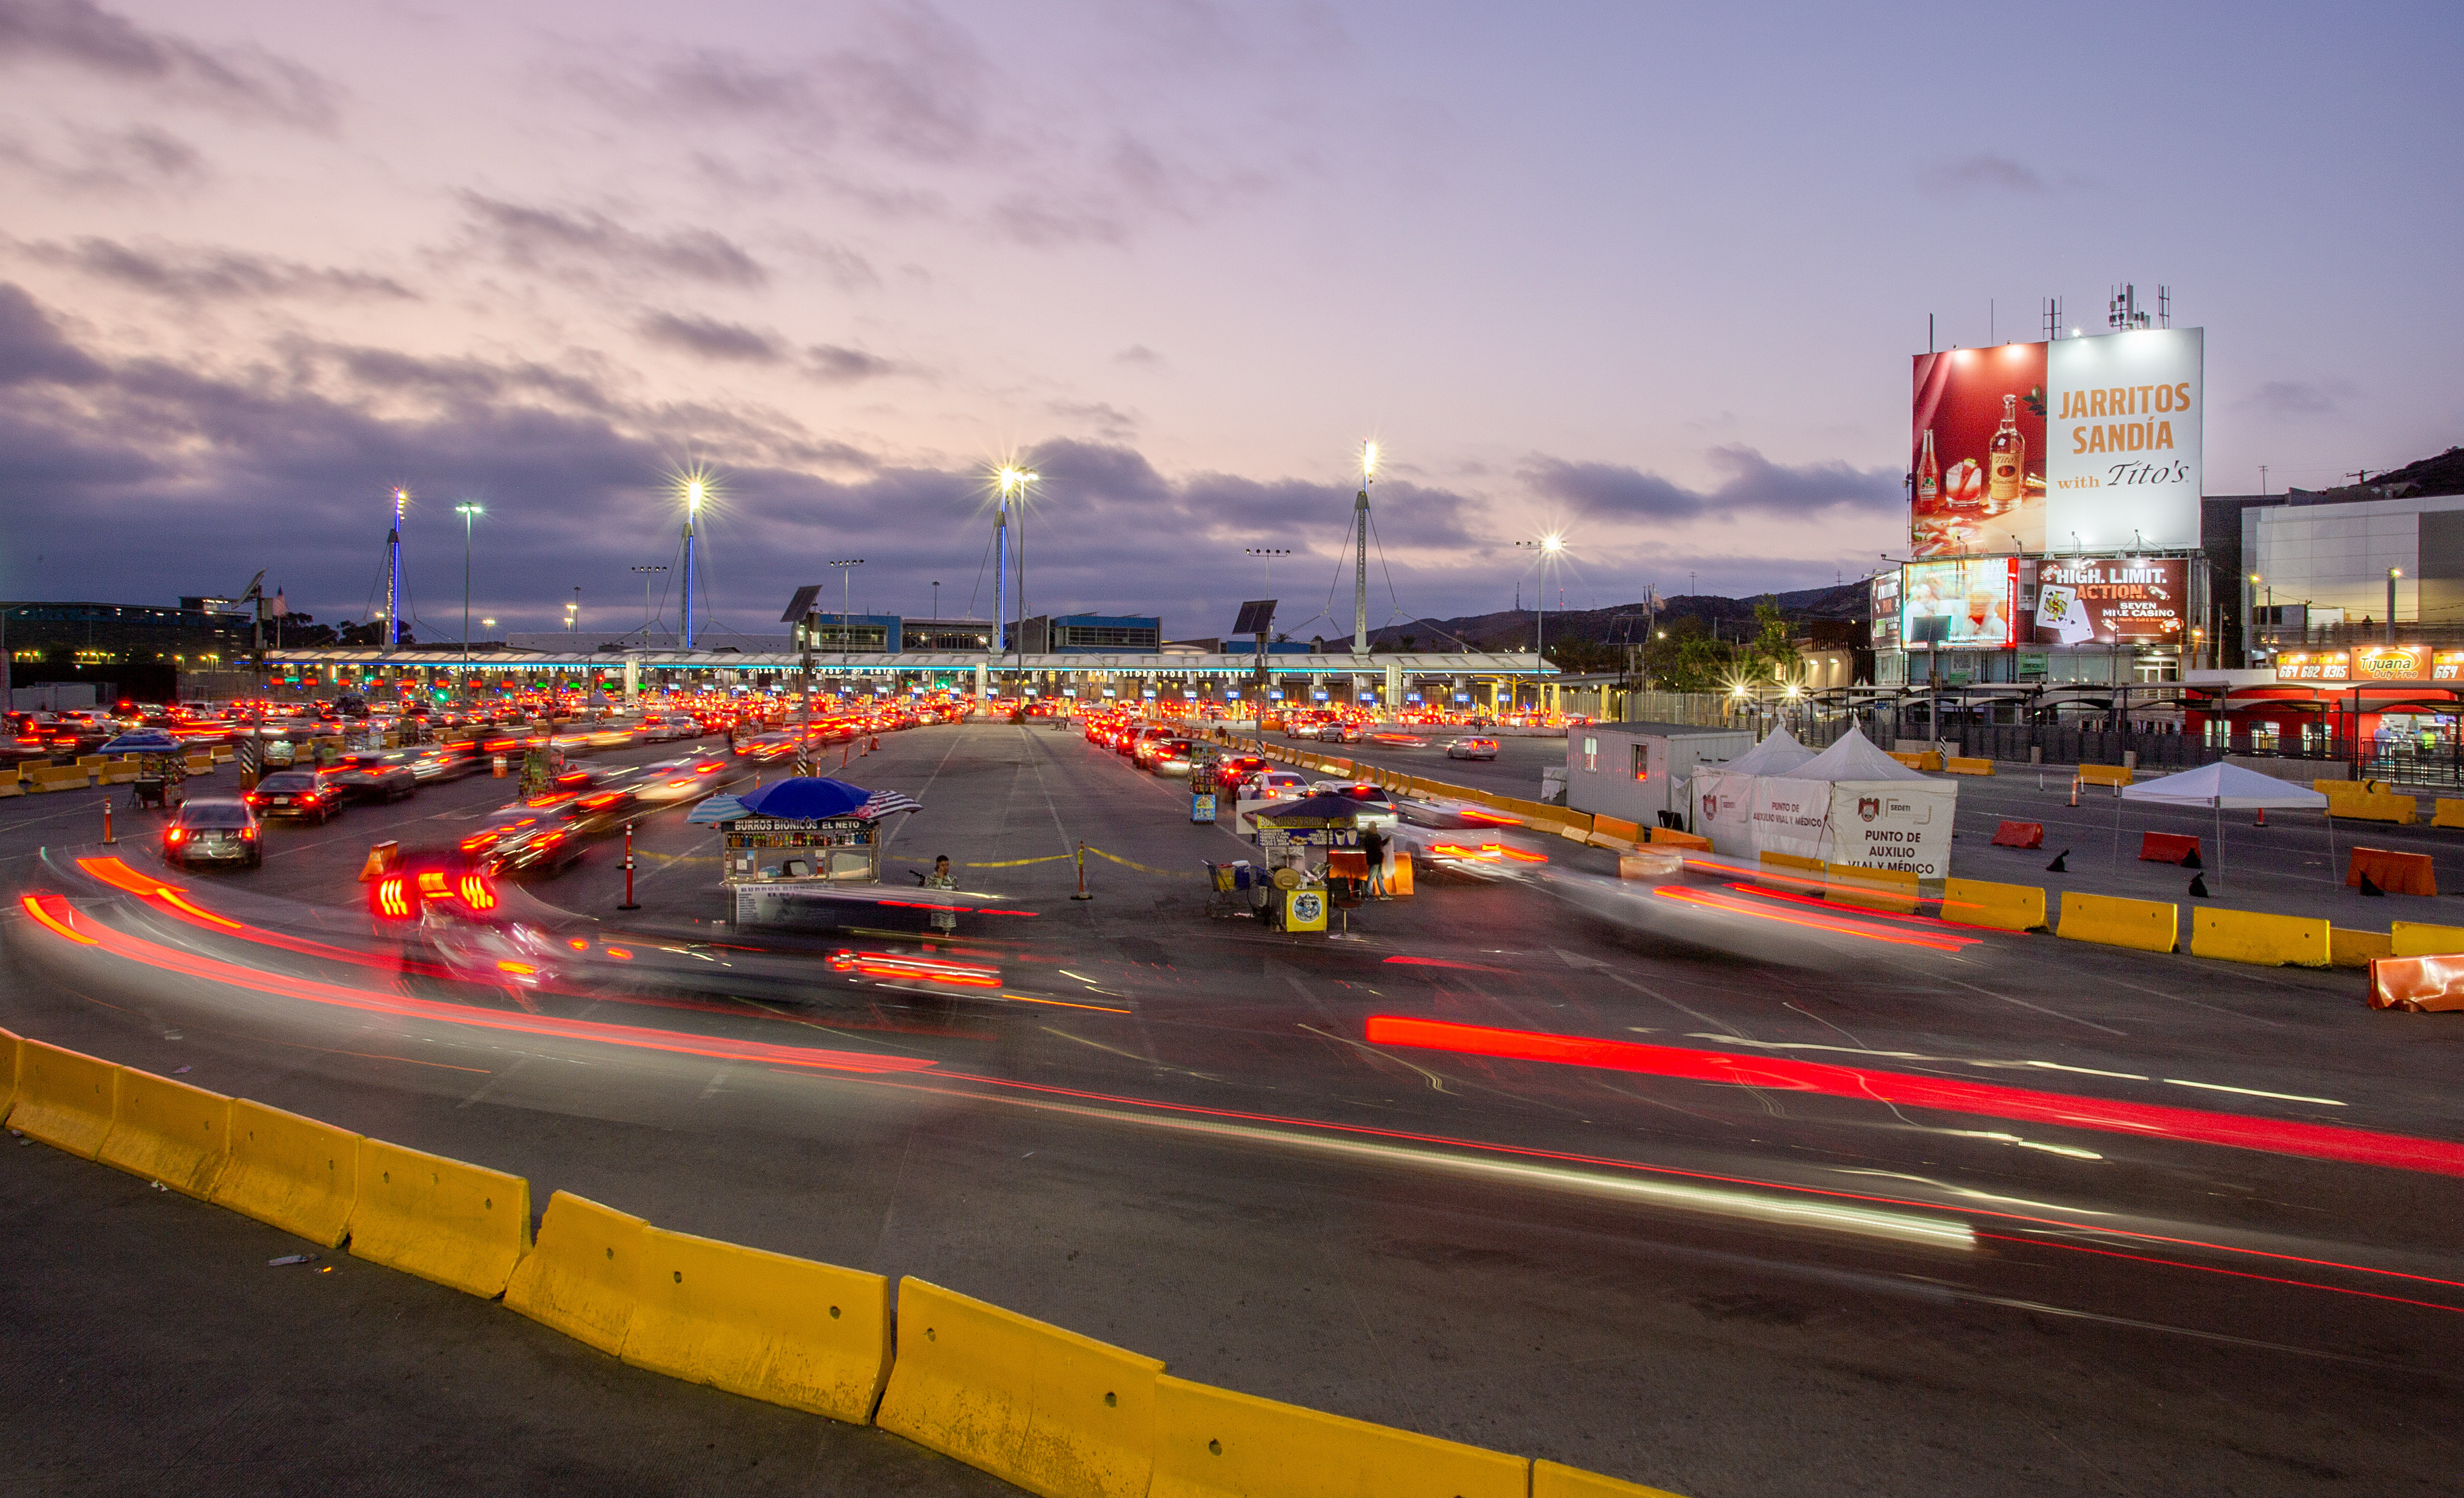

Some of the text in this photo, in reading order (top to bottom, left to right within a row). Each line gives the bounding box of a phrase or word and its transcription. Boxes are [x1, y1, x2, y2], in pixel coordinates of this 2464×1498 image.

[2059, 382, 2190, 419] JARRITOS
[2072, 416, 2174, 454] SANDÍA
[2057, 460, 2189, 489] with Tito's
[2057, 568, 2167, 584] HIGH. LIMIT.
[2076, 585, 2147, 599] ACTION.
[2360, 657, 2411, 671] Tijuana
[2278, 665, 2348, 678] 664 682 8315
[2373, 670, 2418, 680] Duty Free
[2434, 665, 2458, 679] 664
[1772, 802, 1800, 812] PUNTO DE
[735, 821, 771, 830] BURROS
[836, 821, 860, 829] NETO
[1259, 816, 1298, 827] BURRITOS
[1789, 816, 1793, 824] Y
[1795, 815, 1822, 827] MÉDICO
[1865, 830, 1921, 843] PUNTO DE
[1869, 846, 1915, 858] AUXILIO
[1887, 860, 1934, 874] MÉDICO
